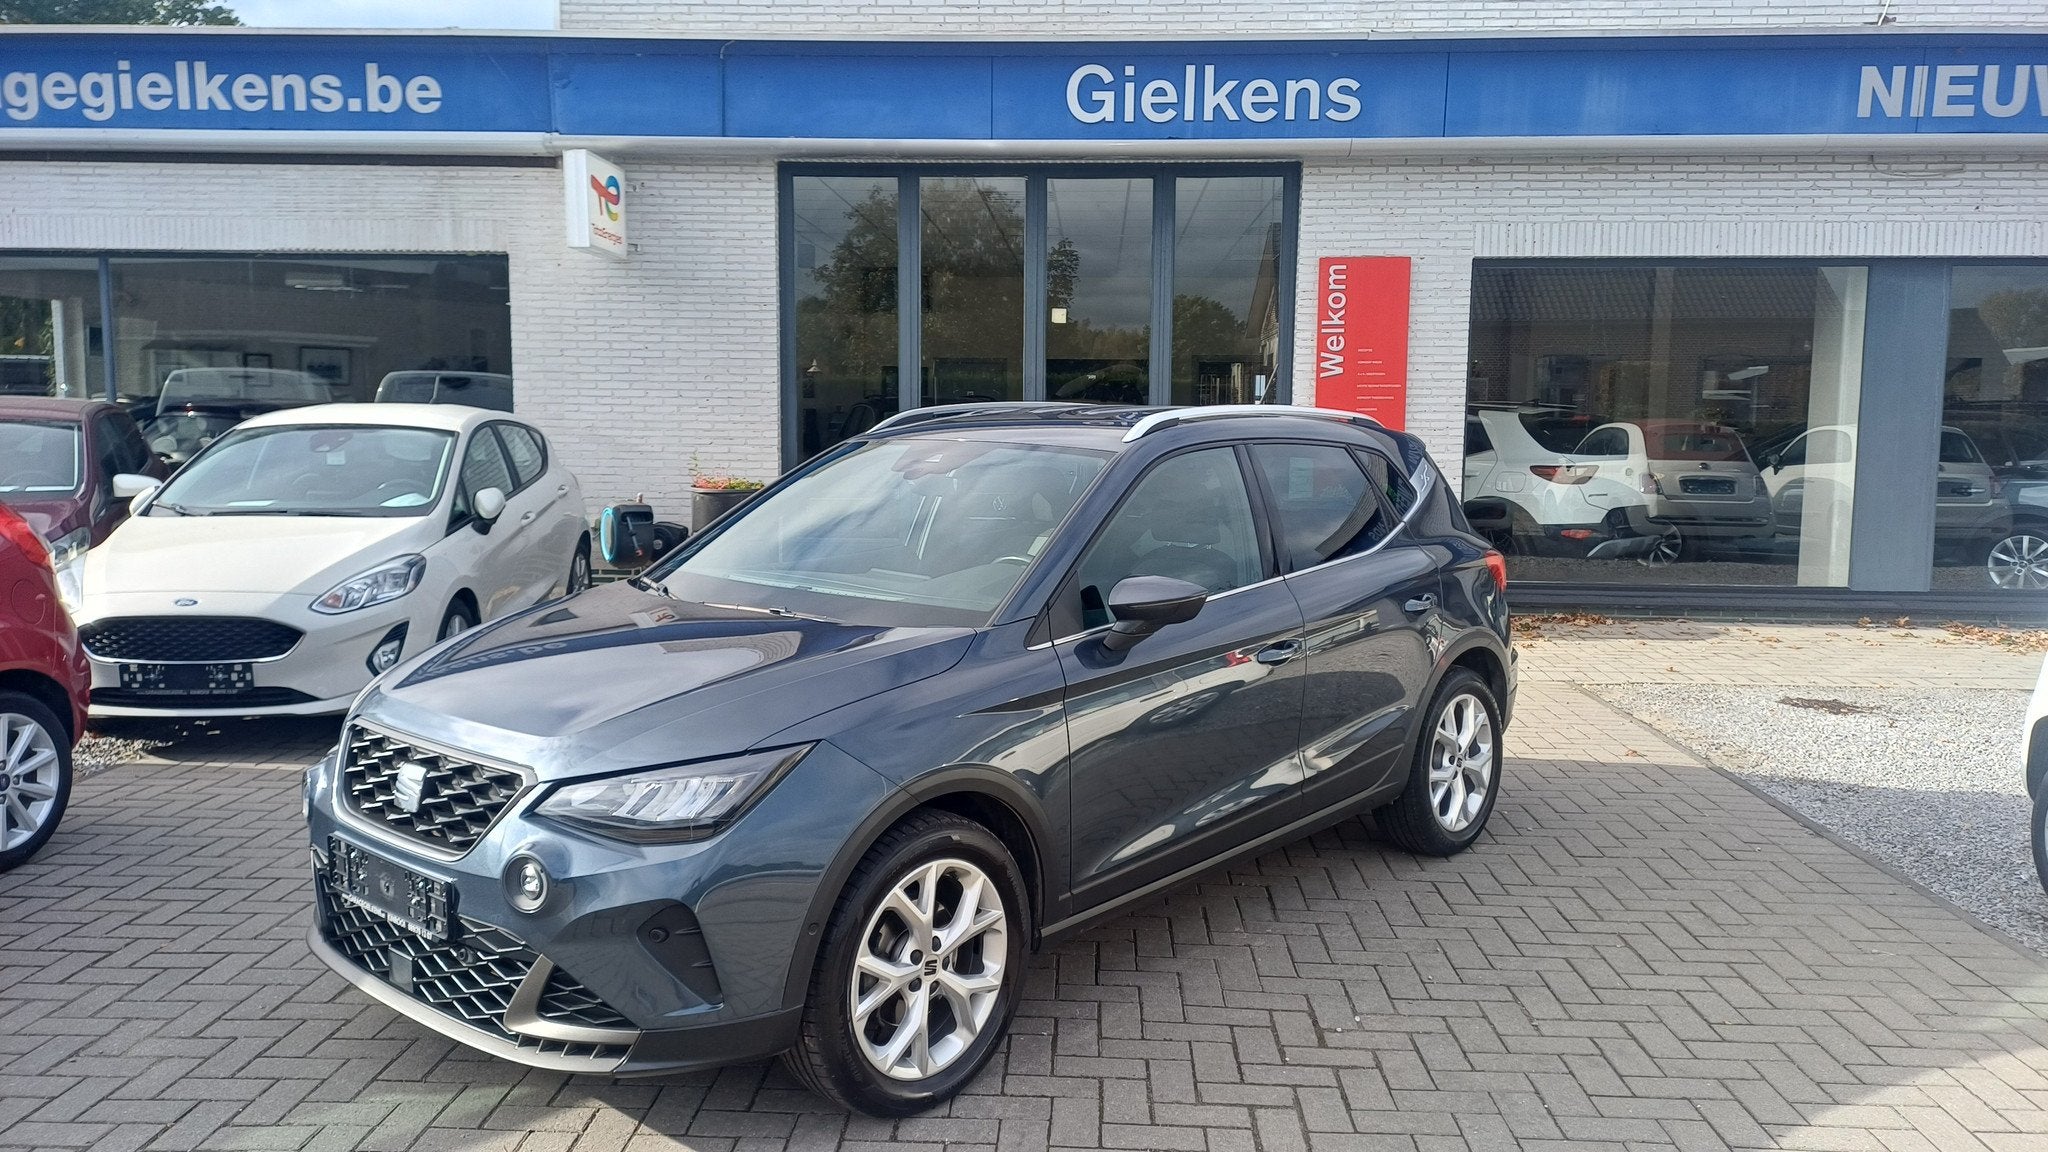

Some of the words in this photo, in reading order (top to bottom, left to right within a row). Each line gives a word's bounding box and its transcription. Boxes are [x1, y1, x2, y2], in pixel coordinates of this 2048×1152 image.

[0, 59, 442, 121] gegielkens.be
[1066, 63, 1362, 124] Gielkens
[1857, 64, 2048, 118] NIEU
[1319, 264, 1347, 378] Welkom
